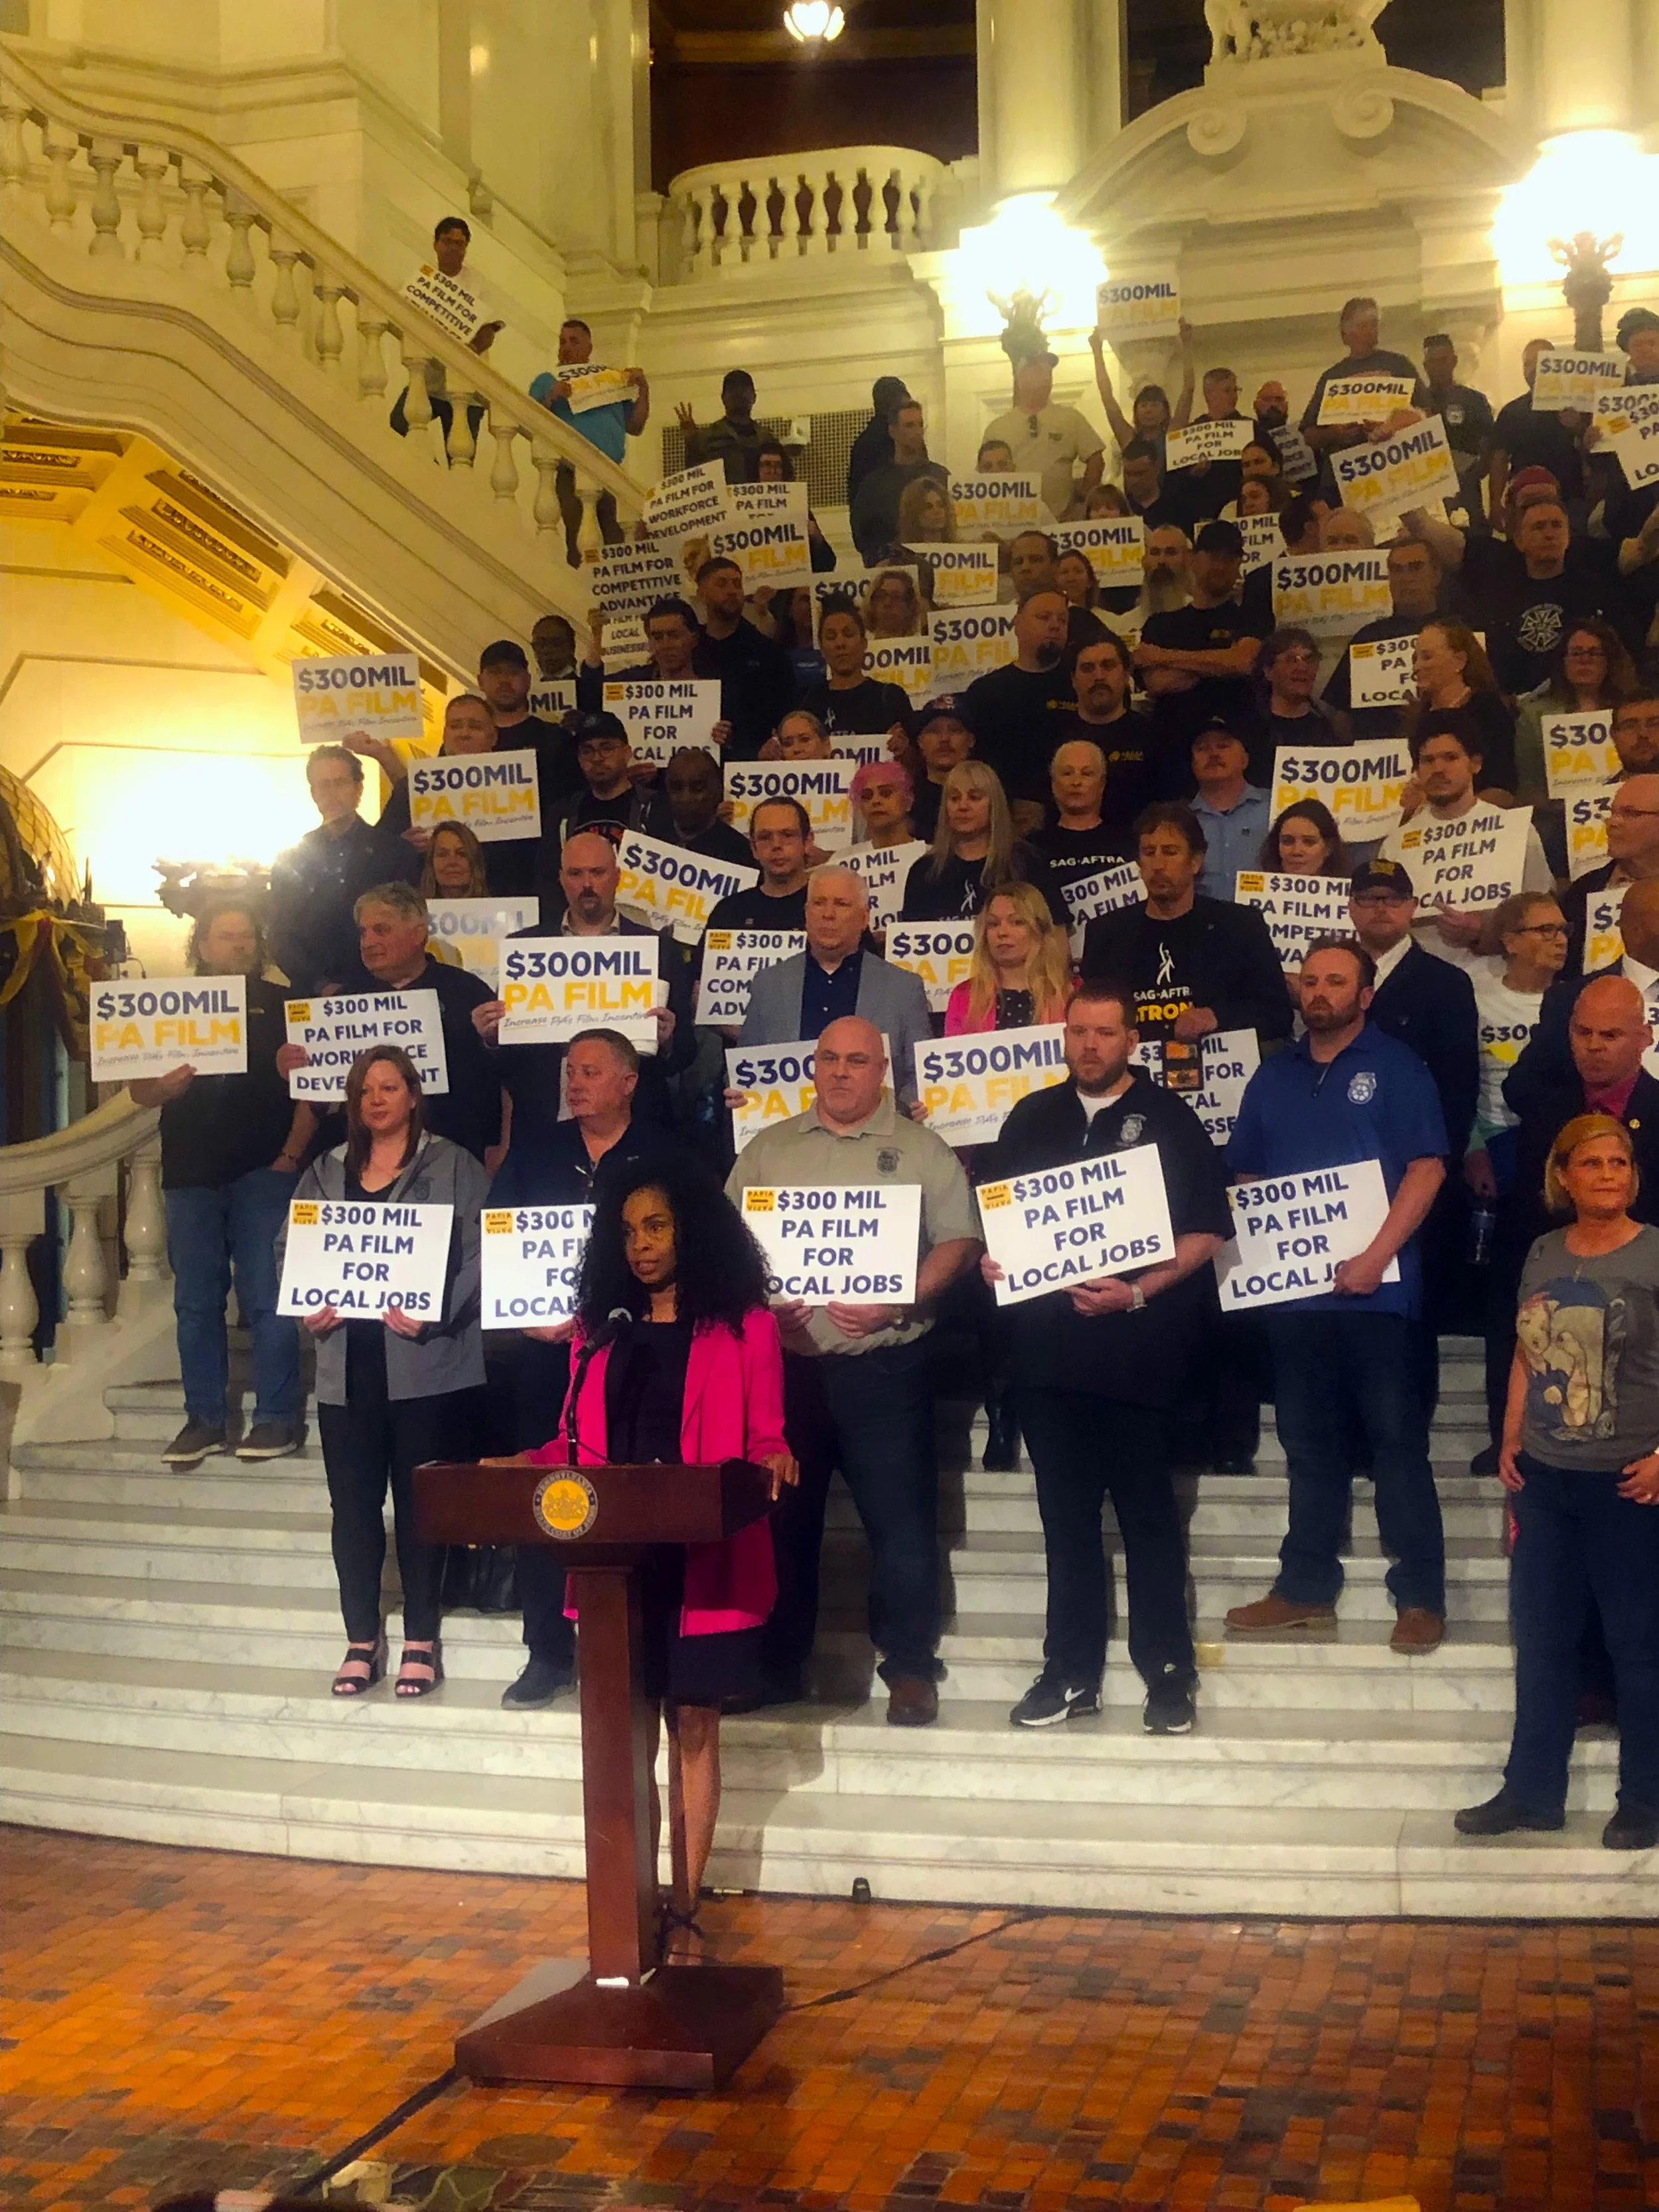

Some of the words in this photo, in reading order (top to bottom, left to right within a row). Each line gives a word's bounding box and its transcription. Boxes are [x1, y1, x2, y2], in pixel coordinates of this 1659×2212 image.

[417, 276, 431, 289] PA
[432, 285, 456, 307] FILM
[455, 303, 477, 323] FOR
[433, 273, 458, 292] $300
[458, 289, 475, 307] MIL
[1099, 283, 1177, 305] $300MIL
[406, 285, 472, 336] COMPETITIVE
[1540, 357, 1622, 378] $300MIL
[1329, 383, 1408, 397] $300MIL
[1204, 431, 1234, 439] FILM
[1214, 421, 1236, 429] MIL
[1196, 440, 1222, 450] FOR
[1339, 430, 1443, 482] $300MIL
[1173, 451, 1214, 467] LOCAL
[660, 474, 685, 491] $300
[686, 467, 706, 480] MIL
[733, 484, 764, 497] $300
[767, 483, 790, 495] MIL
[952, 481, 1037, 500] $300MIL
[650, 498, 663, 509] PA
[666, 488, 690, 504] FILM
[692, 480, 715, 494] FOR
[736, 499, 755, 510] PA
[757, 498, 787, 510] FILM
[648, 496, 719, 524] WORKFORCE
[1252, 516, 1277, 530] MIL
[713, 523, 804, 555] $300MIL
[601, 548, 631, 561] $300
[635, 542, 659, 555] MIL
[593, 567, 611, 579] PA
[613, 563, 644, 577] FILM
[646, 557, 674, 571] FOR
[1277, 561, 1389, 591] $300MIL
[591, 573, 682, 596] COMPETITIVE
[1274, 591, 1313, 616] PA
[1320, 582, 1390, 609] FILM
[933, 616, 1016, 645] $300M
[933, 644, 970, 669] PA
[1381, 656, 1406, 670] PA
[299, 666, 415, 694] $300MIL
[299, 694, 340, 717] PA
[346, 690, 418, 715] FILM
[626, 684, 664, 701] $300
[669, 684, 698, 698] MIL
[1361, 689, 1414, 703] LOCA
[628, 706, 650, 720] PA
[655, 705, 693, 719] FILM
[644, 726, 678, 740] FOR
[1281, 754, 1407, 783] $300MIL
[1550, 751, 1596, 774] PA
[413, 763, 533, 795] $300MIL
[730, 772, 849, 798] $300MIL
[413, 796, 456, 820] PA
[462, 788, 535, 816] FILM
[1423, 823, 1467, 845] $300
[1471, 814, 1504, 833] MIL
[865, 850, 900, 869] MIL
[1423, 847, 1446, 865] PA
[1451, 838, 1496, 859] FILM
[622, 842, 742, 897] $300MIL
[1435, 865, 1474, 885] FOR
[616, 870, 658, 907] PA
[666, 887, 710, 921] FIL
[1062, 883, 1100, 905] 300
[1105, 868, 1140, 892] MIL
[1269, 876, 1320, 894] $300
[1460, 881, 1512, 905] JOBS
[1249, 898, 1277, 914] PA
[1283, 901, 1331, 919] FILM
[737, 932, 783, 950] $300
[892, 932, 975, 958] $300
[505, 950, 652, 981] $300MIL
[715, 956, 741, 971] PA
[96, 989, 240, 1021] $300MIL
[323, 1000, 368, 1017] $300
[374, 995, 407, 1012] MIL
[504, 984, 555, 1012] PA
[563, 981, 652, 1010] FILM
[96, 1021, 145, 1051] PA
[155, 1017, 242, 1047] FILM
[305, 1027, 329, 1043] PA
[335, 1023, 379, 1040] FILM
[384, 1019, 423, 1036] FOR
[735, 1054, 816, 1088] $300
[922, 1038, 1066, 1084] $300MIL
[1205, 1062, 1246, 1081] FOR
[738, 1089, 792, 1122] PA
[923, 1082, 978, 1116] PA
[1013, 1170, 1075, 1203] $300
[1080, 1159, 1127, 1185] MIL
[1235, 1181, 1297, 1211] $300
[1301, 1172, 1349, 1197] MIL
[777, 1189, 837, 1212] $300
[843, 1190, 887, 1210] MIL
[1024, 1204, 1061, 1229] PA
[1065, 1187, 1125, 1219] FILM
[321, 1205, 376, 1226] $300
[382, 1207, 423, 1227] MIL
[516, 1210, 575, 1234] $300
[781, 1219, 815, 1238] PA
[822, 1218, 879, 1238] FILM
[1247, 1214, 1284, 1236] PA
[1287, 1200, 1348, 1229] FILM
[323, 1233, 354, 1253] PA
[360, 1234, 414, 1255] FILM
[522, 1238, 555, 1260] PA
[1054, 1222, 1107, 1252] FOR
[1277, 1234, 1331, 1260] FOR
[803, 1247, 854, 1267] FOR
[1007, 1255, 1093, 1293] LOCAL
[1099, 1234, 1161, 1268] JOBS
[342, 1262, 390, 1282] FOR
[1231, 1267, 1318, 1299] LOCAL
[766, 1275, 835, 1295] OCAL
[841, 1274, 903, 1295] JOBS
[291, 1288, 374, 1309] LOCAL
[376, 1290, 431, 1311] JOBS
